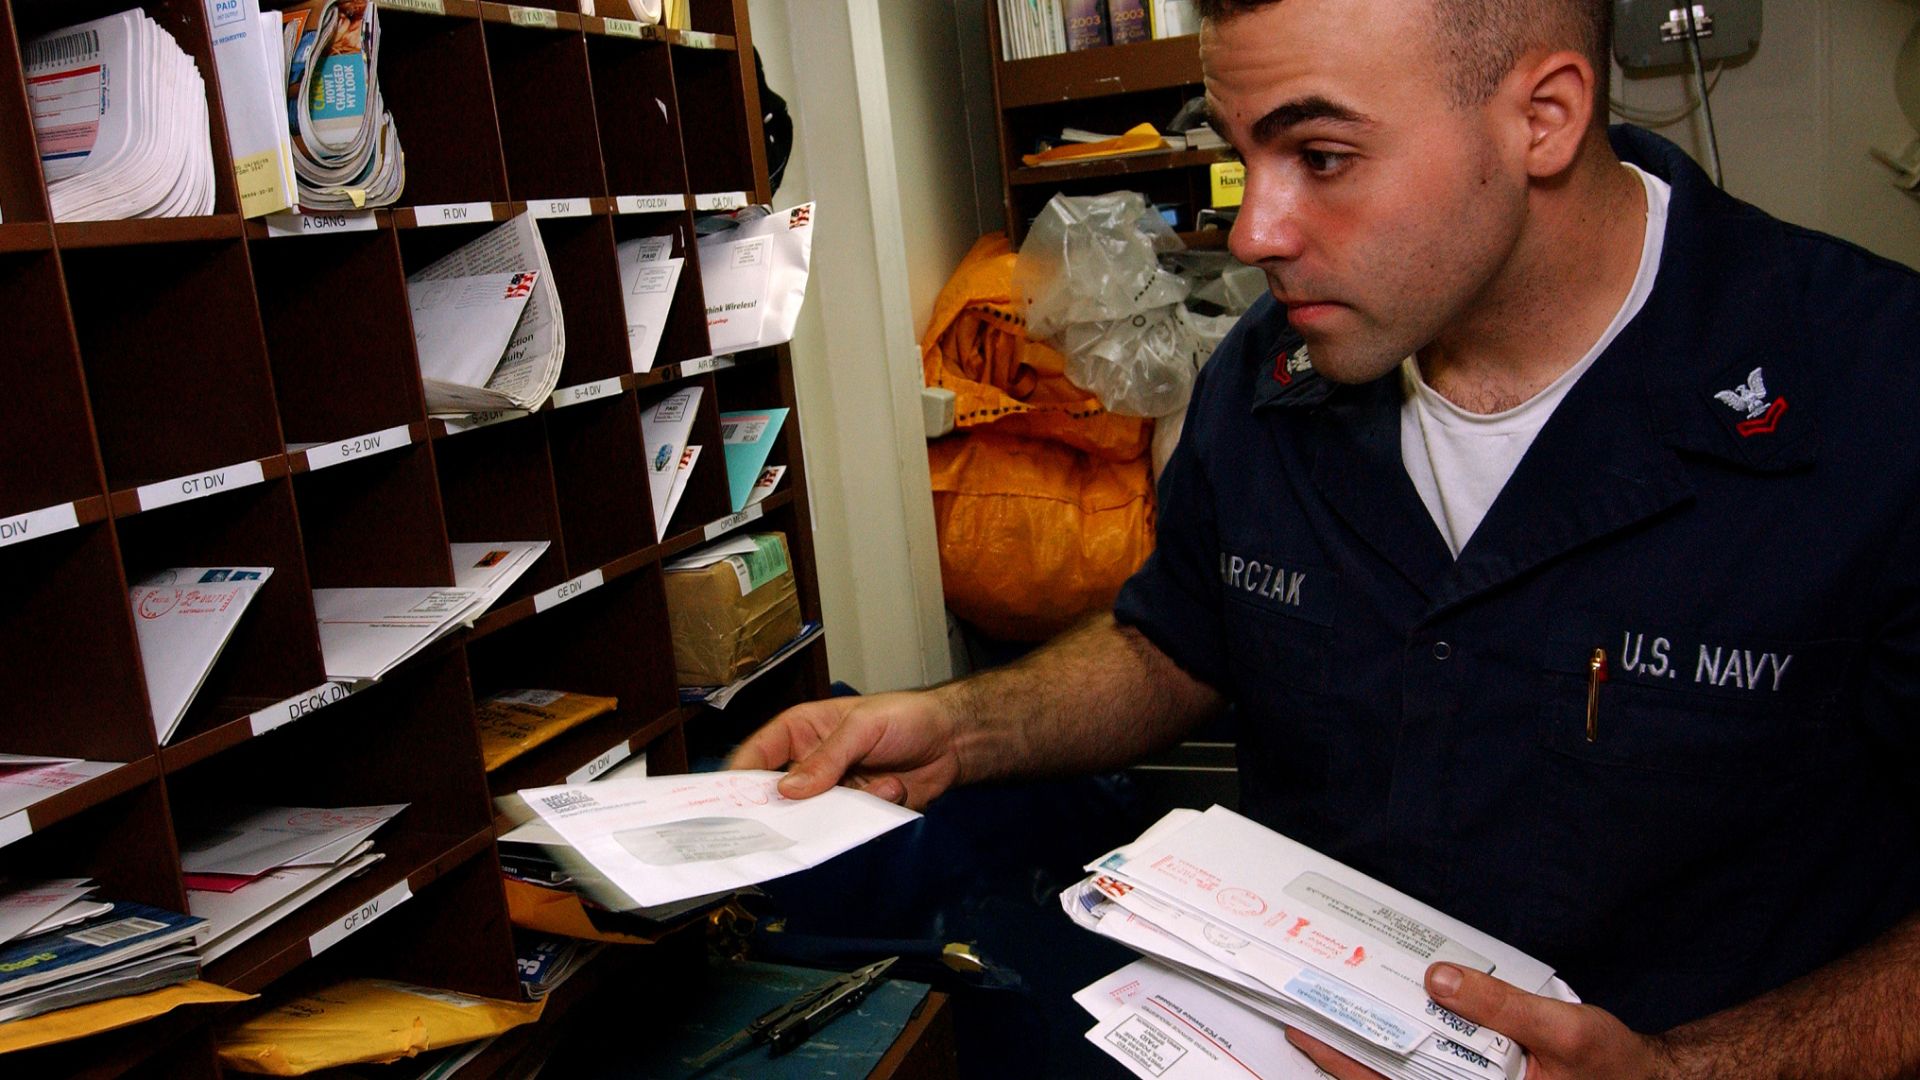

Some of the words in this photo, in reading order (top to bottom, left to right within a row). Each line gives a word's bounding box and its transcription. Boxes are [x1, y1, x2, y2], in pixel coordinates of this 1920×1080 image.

[216, 0, 237, 11] PAID
[1114, 8, 1145, 21] 2003
[609, 20, 634, 32] LEAVE
[1071, 15, 1101, 28] 2003
[344, 64, 356, 92] LOOK
[324, 79, 335, 104] HOW
[333, 64, 345, 111] CHANGED
[346, 91, 356, 109] MY
[551, 204, 556, 213] E
[558, 203, 570, 213] DIV
[657, 199, 668, 208] DIV
[712, 198, 722, 208] CA
[723, 198, 734, 207] DIV
[303, 217, 311, 229] A
[314, 215, 346, 228] GANG
[444, 209, 450, 219] R
[452, 207, 467, 218] DIV
[725, 300, 757, 312] Wireless!
[574, 387, 589, 399] S-4
[589, 385, 601, 396] DIV
[341, 441, 361, 456] S-2
[363, 436, 381, 450] DIV
[182, 479, 200, 495] CT
[204, 473, 225, 489] DIV
[0, 520, 28, 539] DIV
[557, 586, 569, 598] CE
[570, 580, 582, 594] DIV
[1621, 631, 1676, 679] U.S.
[1694, 644, 1794, 691] NAVY
[288, 690, 328, 720] DECK
[331, 682, 353, 702] DIV
[598, 754, 610, 769] DIV
[541, 791, 569, 801] NAVY
[344, 913, 359, 930] CF
[361, 900, 379, 920] DIV
[1155, 994, 1183, 1014] Enclosed
[1183, 1011, 1205, 1029] Invoice
[1427, 999, 1478, 1031] FEDERAL
[1204, 1027, 1218, 1039] PCS
[1439, 1016, 1477, 1037] NAVY
[1124, 1032, 1151, 1053] POSTAGE
[1140, 1034, 1158, 1050] PAID
[1218, 1037, 1232, 1050] Your
[1128, 1038, 1165, 1070] FIRST-CLASS
[1451, 1050, 1489, 1069] NAVY
